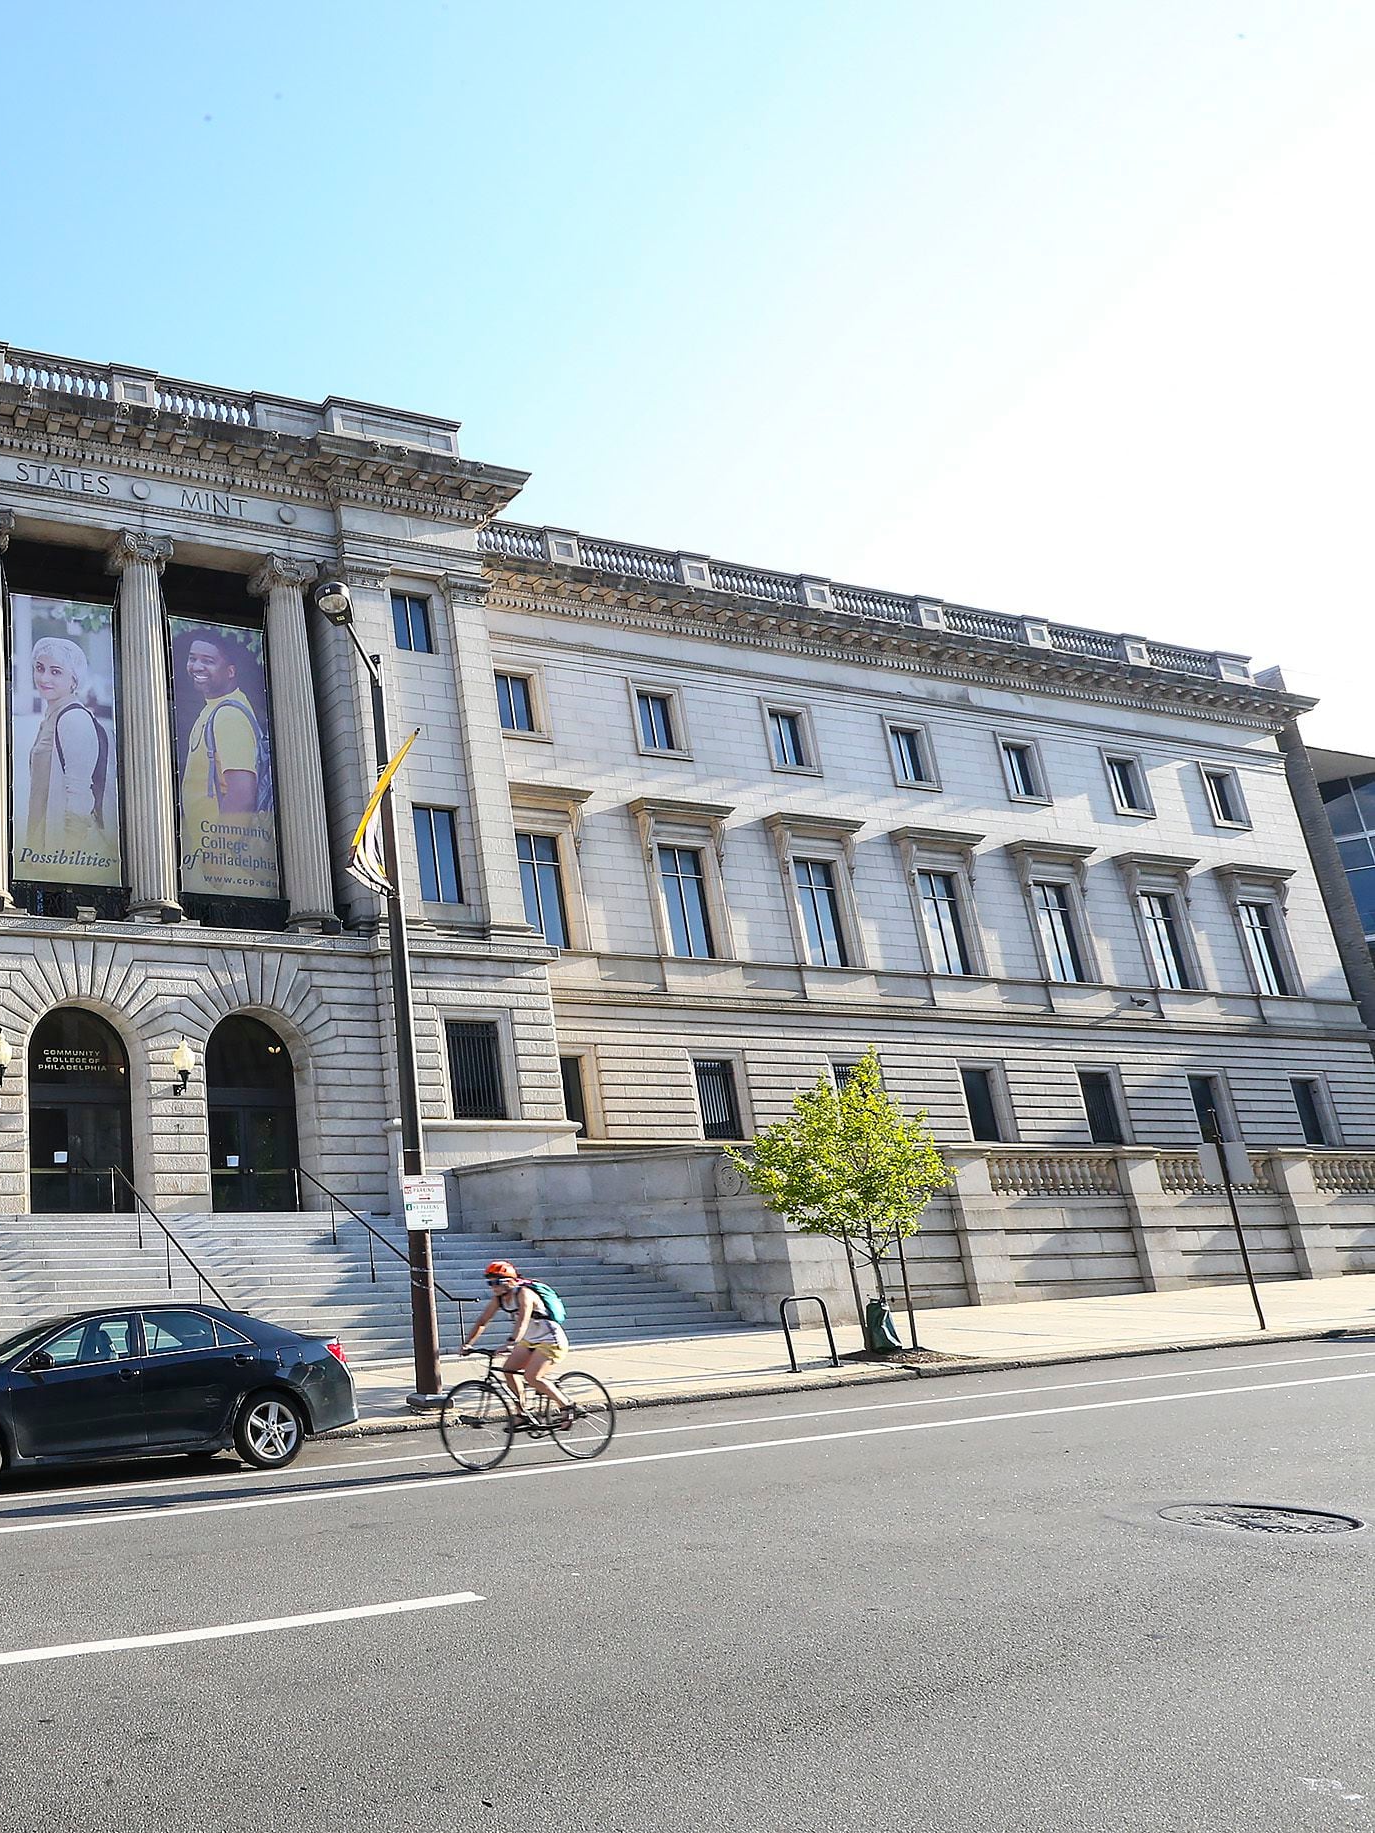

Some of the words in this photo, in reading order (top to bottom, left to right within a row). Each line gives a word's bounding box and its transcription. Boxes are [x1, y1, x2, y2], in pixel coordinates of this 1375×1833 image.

[16, 462, 110, 495] STATES
[181, 489, 248, 517] MINT
[200, 820, 272, 841] Community
[201, 836, 249, 854] College
[183, 848, 203, 870] of
[202, 851, 277, 871] Philadelphia
[203, 875, 278, 888] www.ccp.edu
